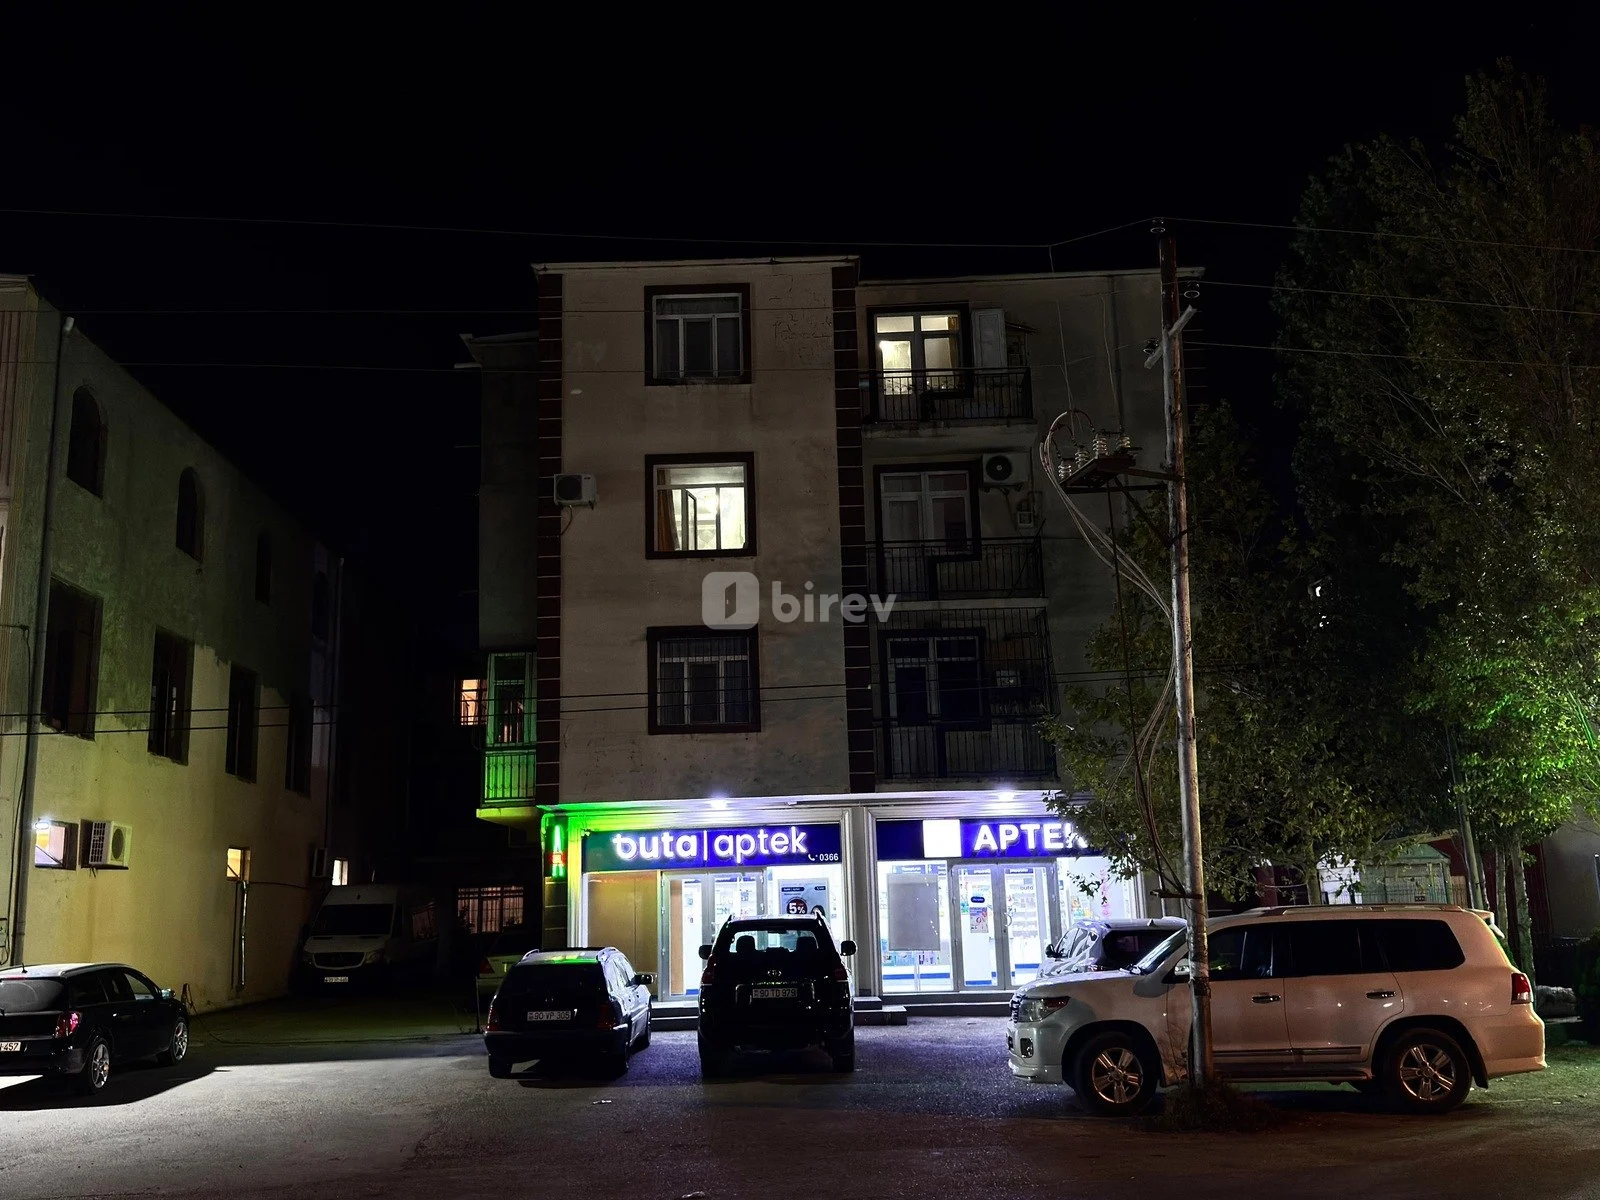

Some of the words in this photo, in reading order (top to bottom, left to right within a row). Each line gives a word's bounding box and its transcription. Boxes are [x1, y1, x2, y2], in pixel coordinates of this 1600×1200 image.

[612, 832, 698, 860] buta
[714, 826, 807, 864] aptek
[819, 853, 839, 861] 0366
